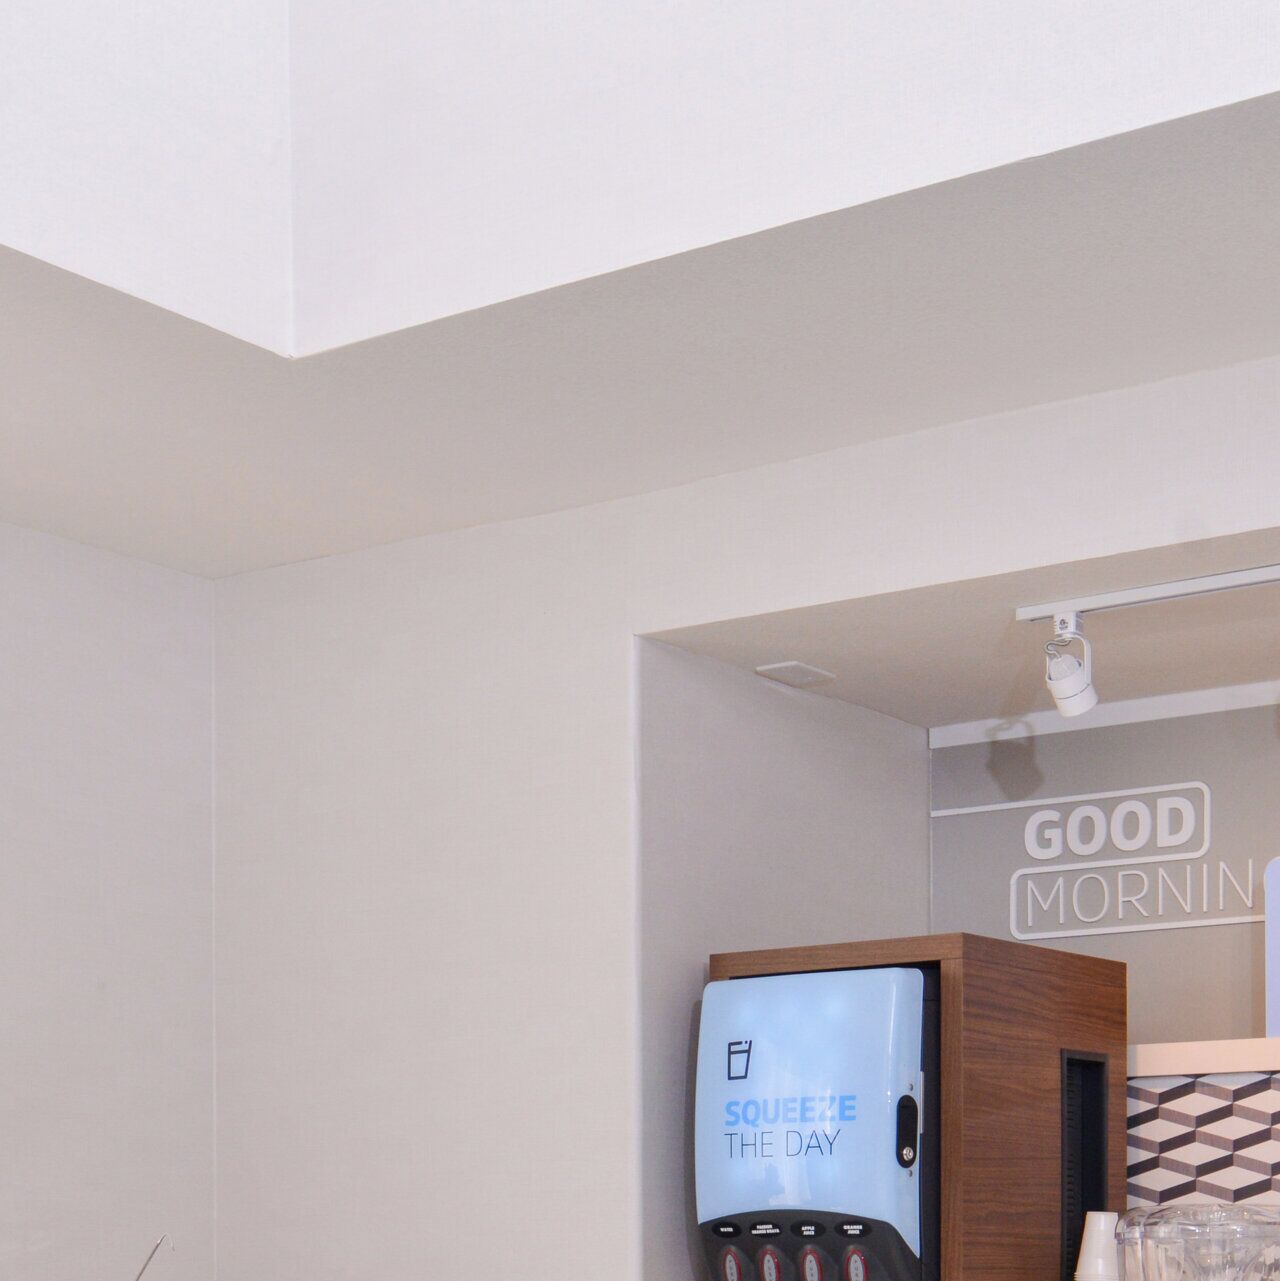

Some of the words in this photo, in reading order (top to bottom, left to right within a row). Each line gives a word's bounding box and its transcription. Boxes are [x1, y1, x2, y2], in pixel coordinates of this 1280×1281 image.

[1024, 797, 1196, 860] GOOD
[1027, 859, 1254, 927] MORNIN
[724, 1095, 857, 1127] SQUEEZE
[724, 1131, 773, 1158] THE
[785, 1129, 841, 1156] DAY
